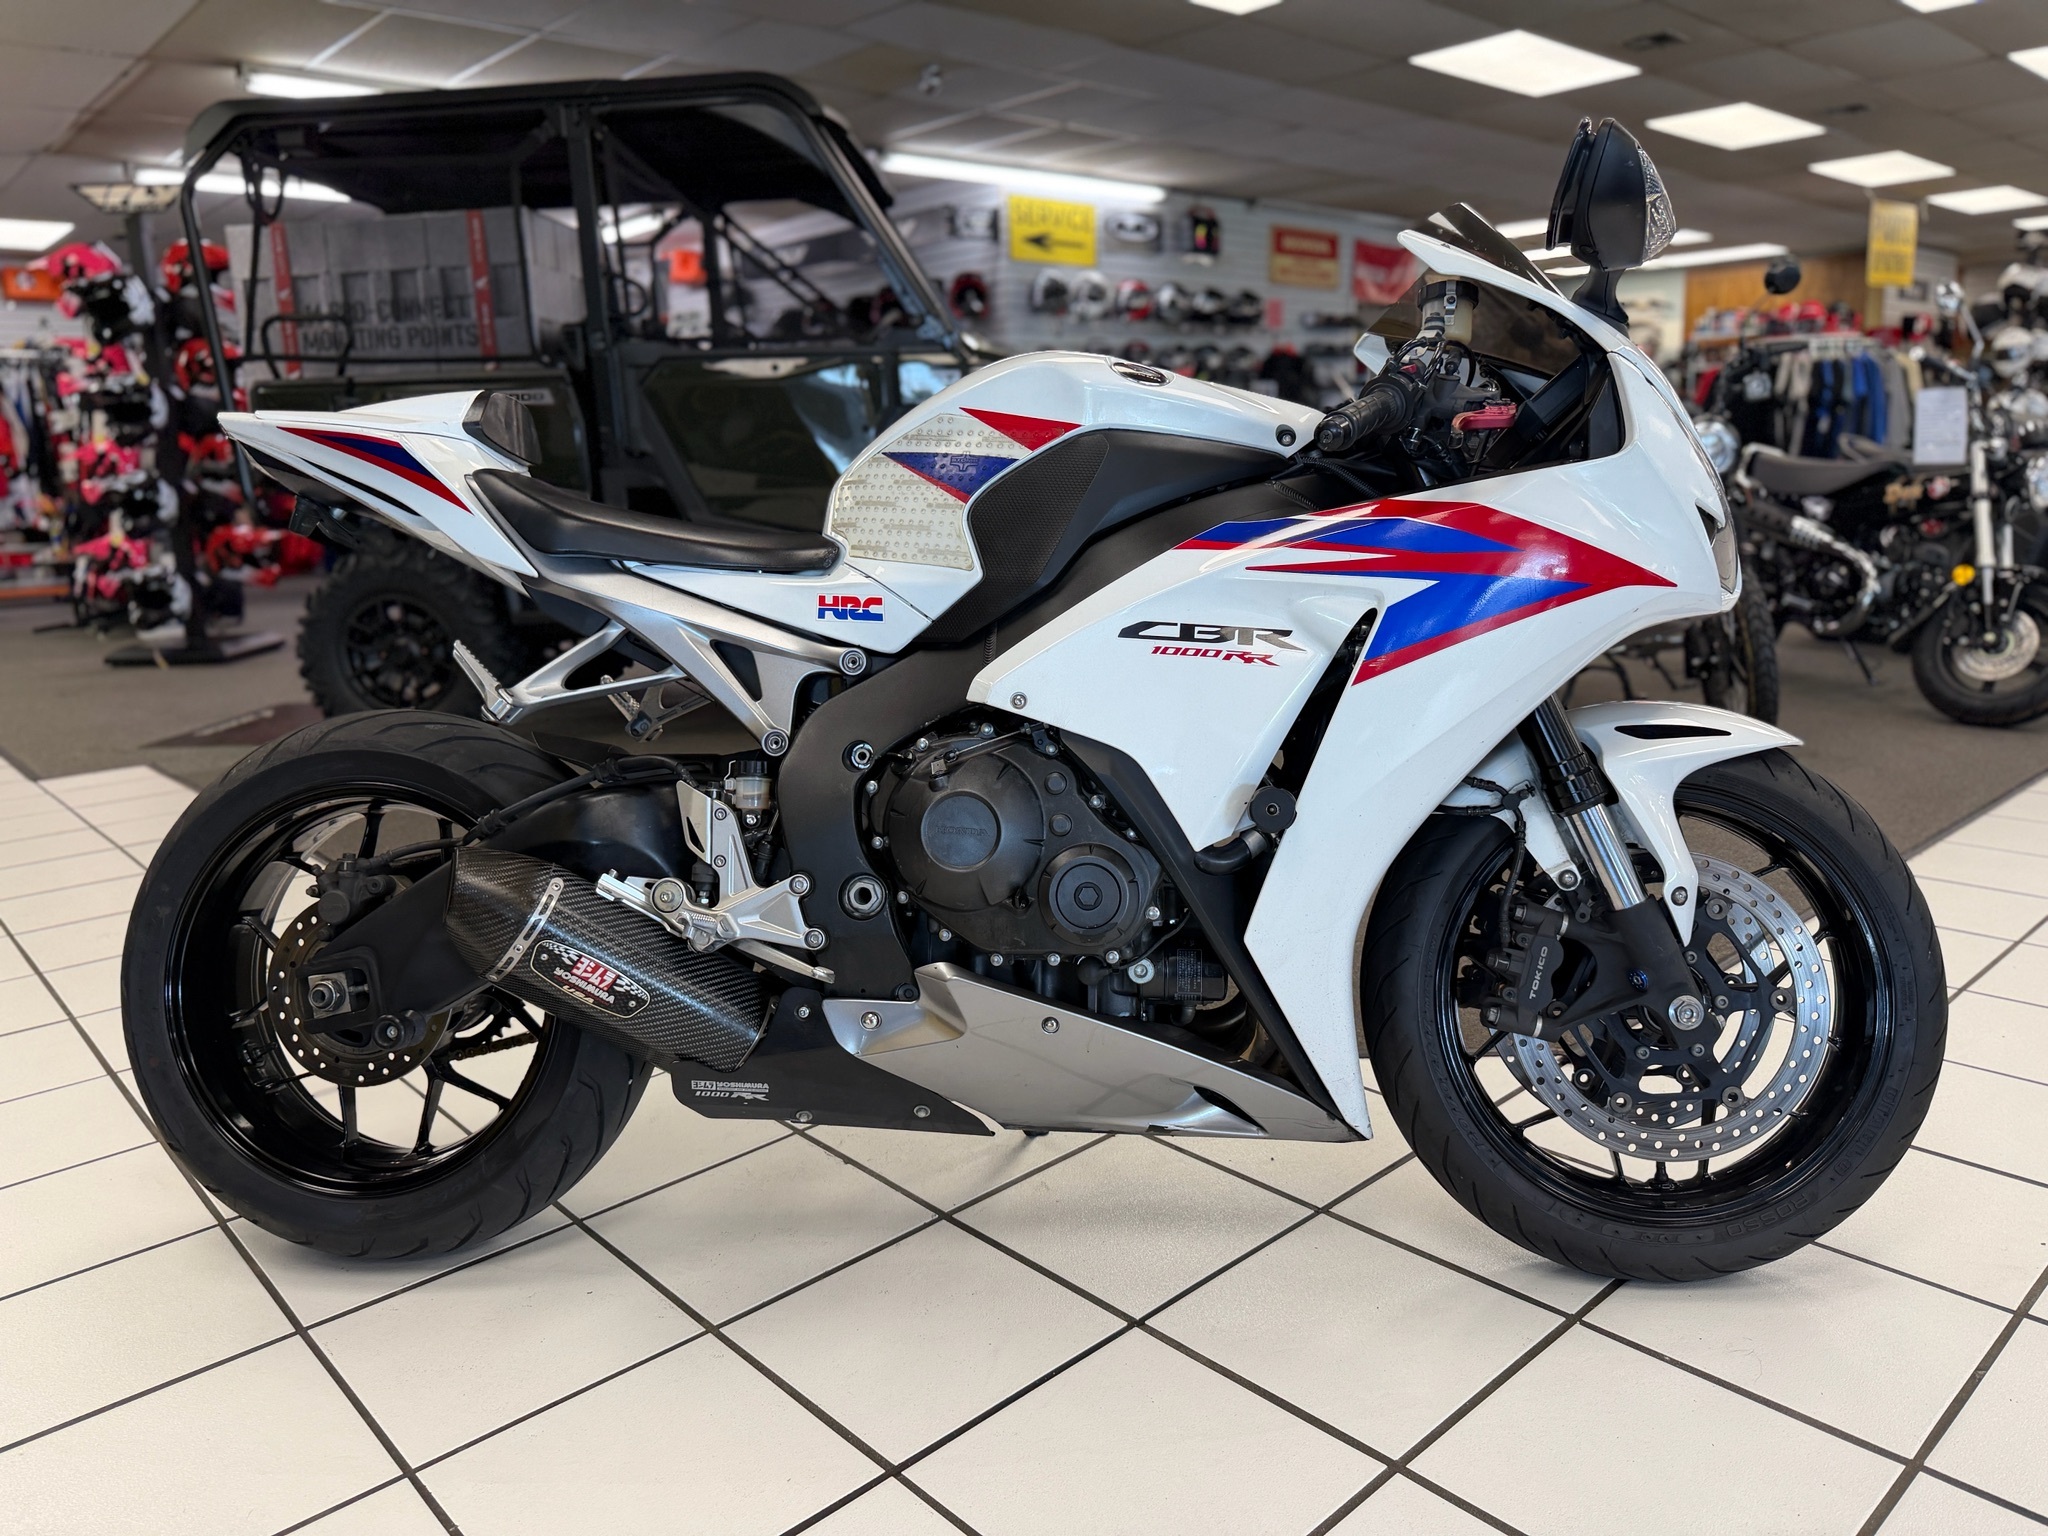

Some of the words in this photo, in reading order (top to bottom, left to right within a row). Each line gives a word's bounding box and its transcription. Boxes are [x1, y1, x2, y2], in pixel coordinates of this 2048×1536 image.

[407, 323, 480, 348] POINTS
[818, 595, 883, 621] HRC
[1118, 621, 1306, 652] CBR
[936, 825, 989, 837] HONDA
[553, 967, 615, 1004] YOSHIMURA
[1529, 946, 1548, 999] TOKICO
[717, 1081, 769, 1089] YOSHIMURA
[1725, 1191, 1809, 1237] ROSSO
